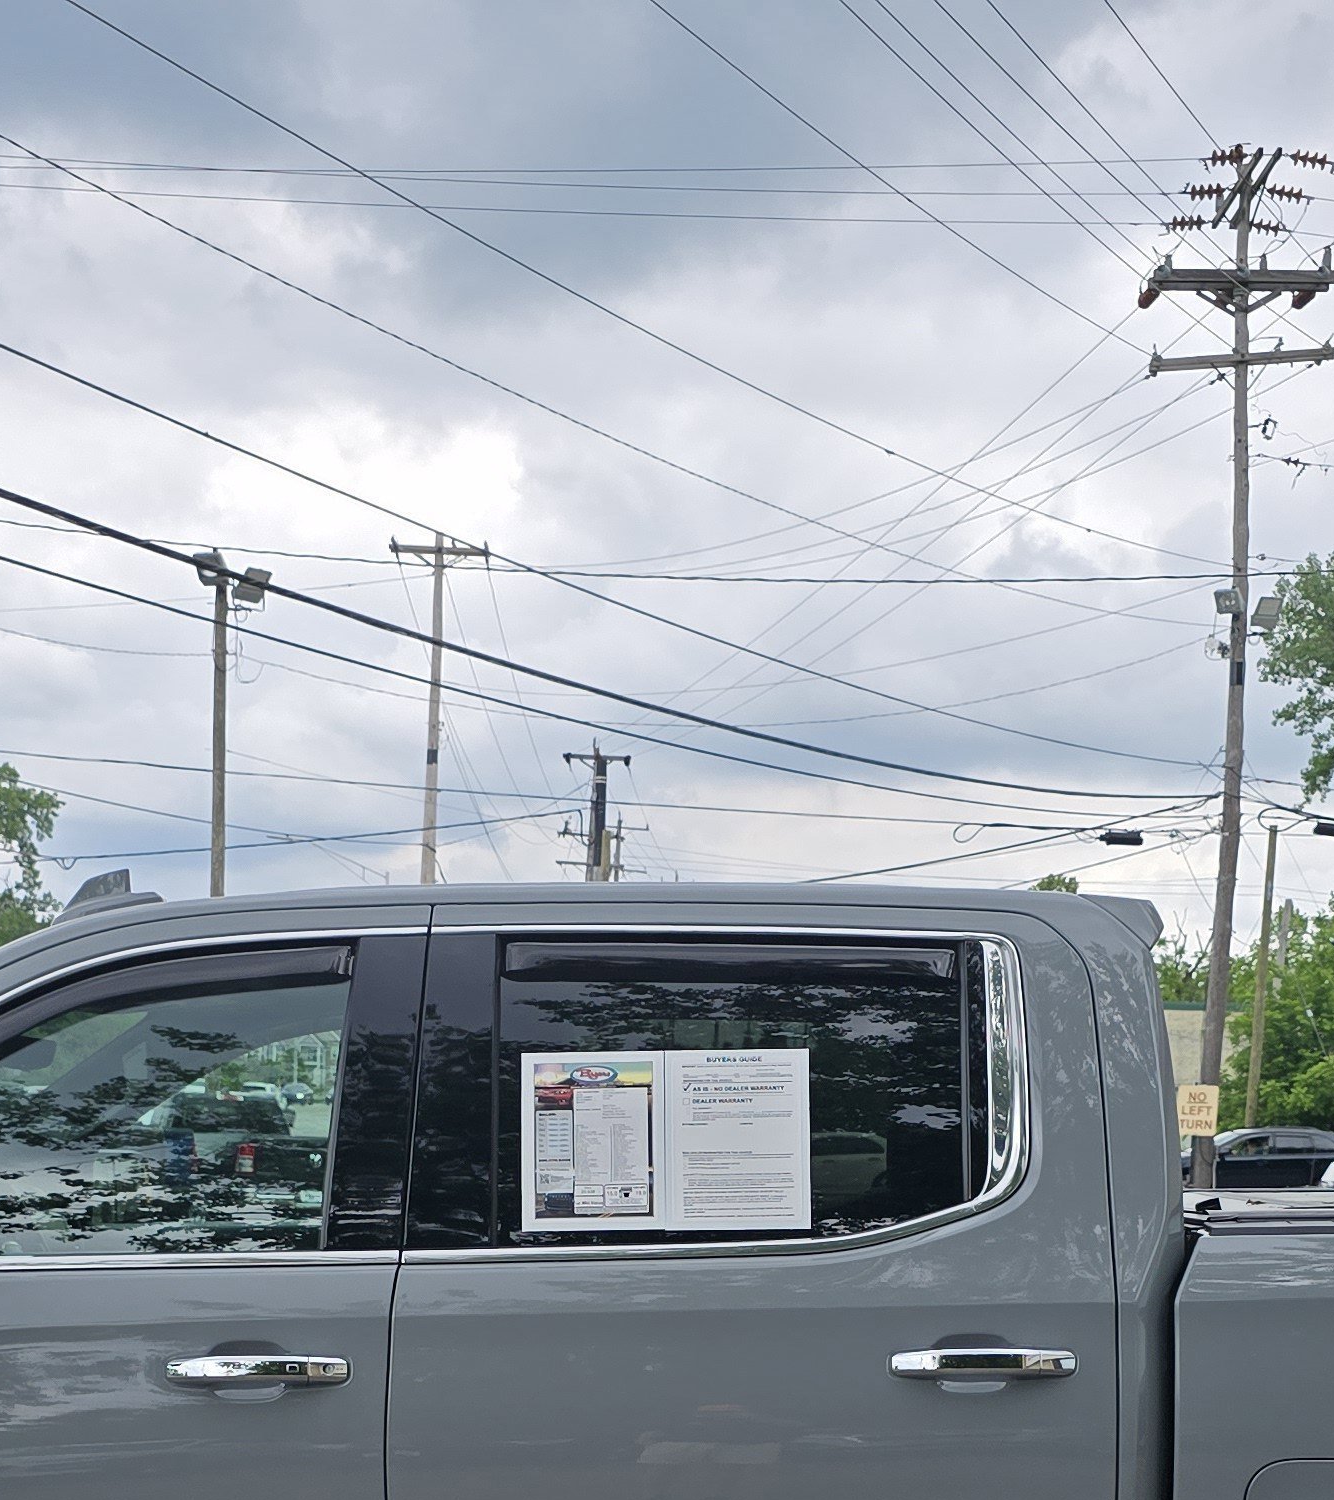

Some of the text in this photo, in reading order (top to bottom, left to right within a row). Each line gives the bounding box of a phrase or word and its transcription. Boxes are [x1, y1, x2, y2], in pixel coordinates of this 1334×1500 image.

[1188, 1091, 1208, 1102] NO
[1181, 1105, 1213, 1116] LEFT
[1180, 1119, 1213, 1130] TURN
